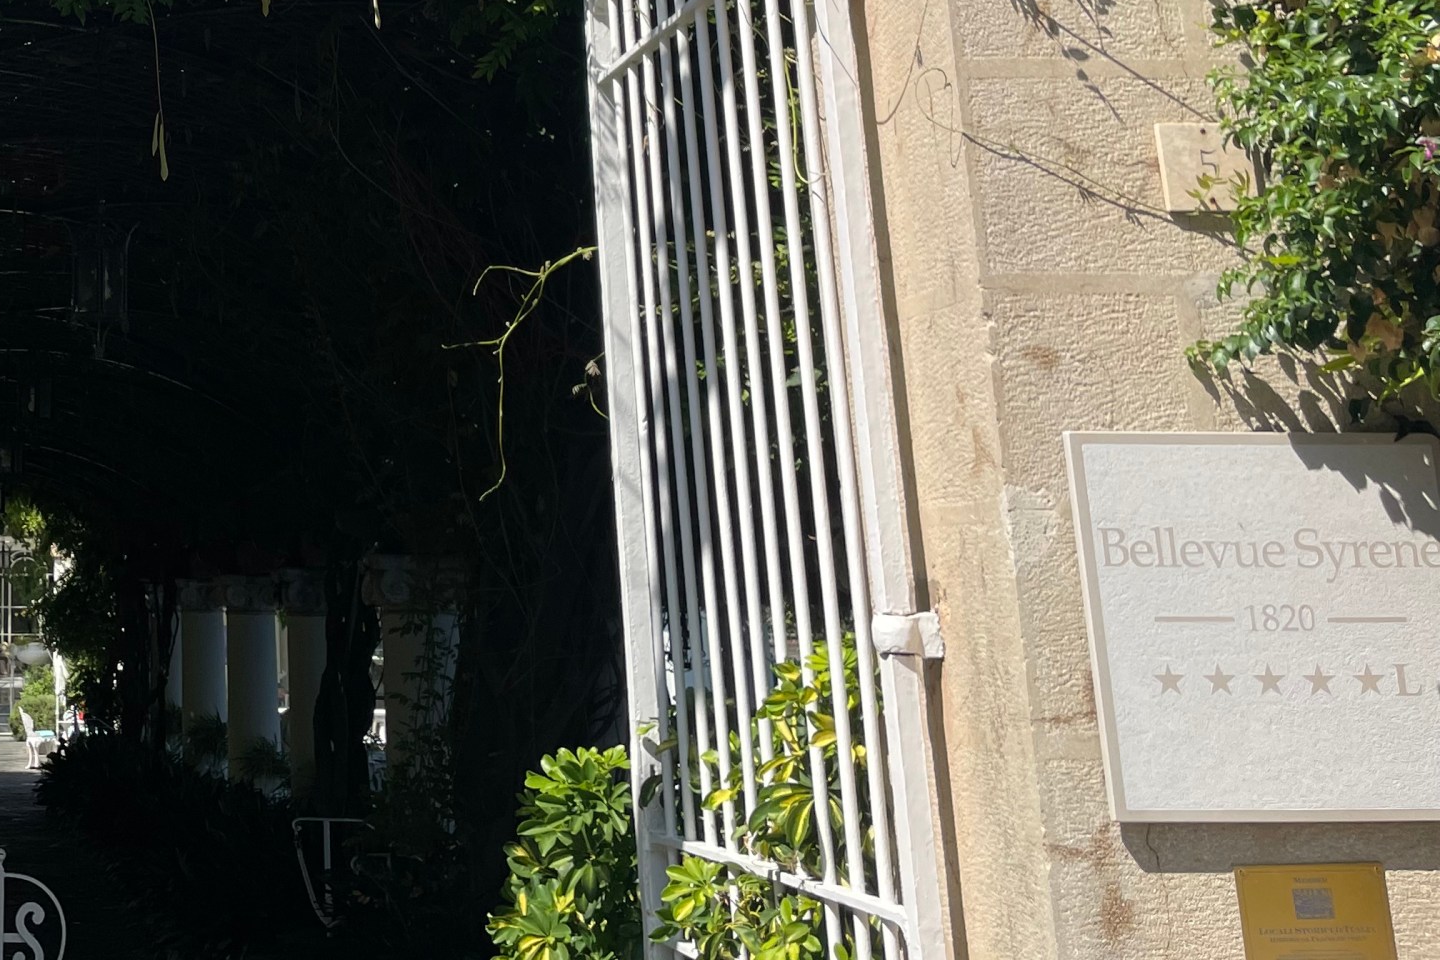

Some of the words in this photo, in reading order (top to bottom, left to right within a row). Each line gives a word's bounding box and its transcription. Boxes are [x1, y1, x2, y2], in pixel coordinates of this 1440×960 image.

[1097, 526, 1286, 570] Bellevue
[1293, 527, 1440, 583] Syrene
[1243, 604, 1315, 632] 1820
